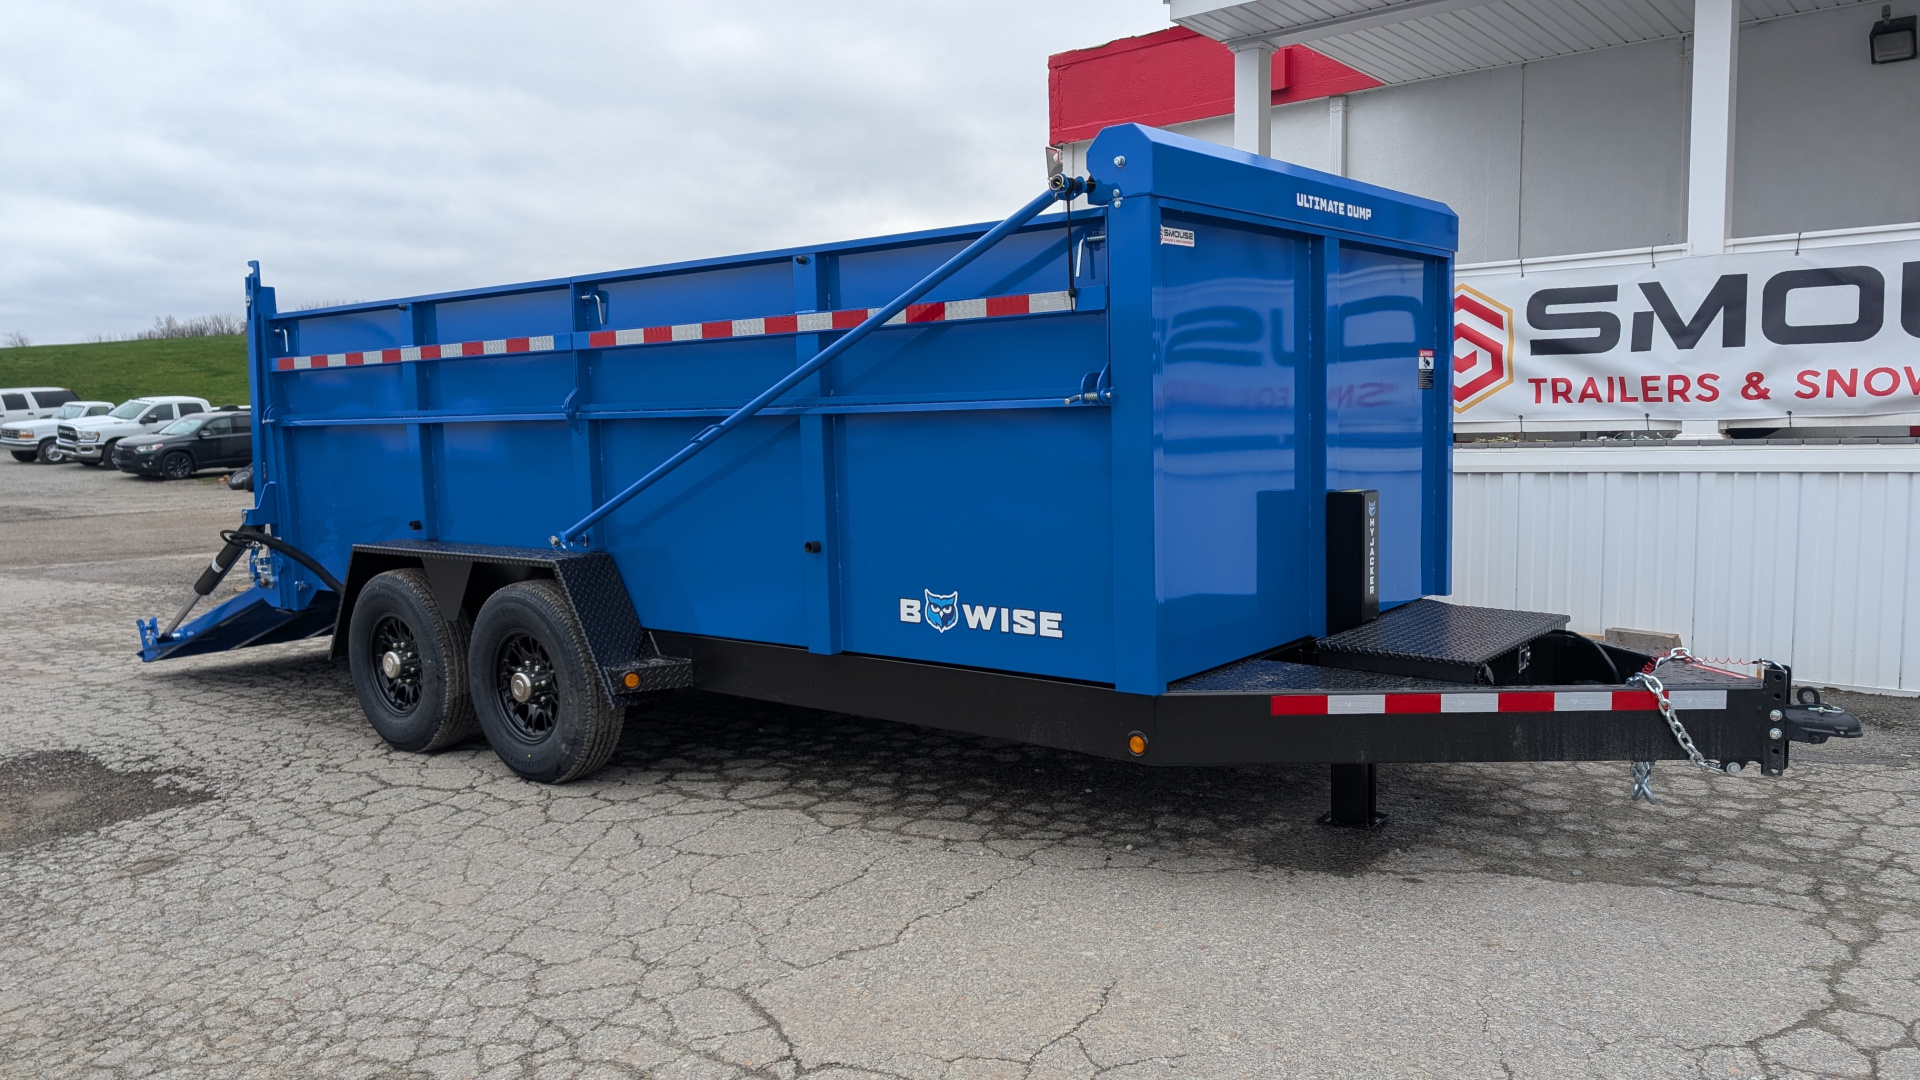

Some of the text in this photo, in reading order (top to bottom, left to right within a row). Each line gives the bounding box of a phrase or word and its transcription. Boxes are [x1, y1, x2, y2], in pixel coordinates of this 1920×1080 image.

[1296, 192, 1372, 220] ULTIMATE DUMP
[1163, 229, 1193, 240] SMOUSE
[1526, 262, 1920, 356] SMO
[1528, 373, 1720, 403] TRAILERS
[1740, 371, 1772, 400] &
